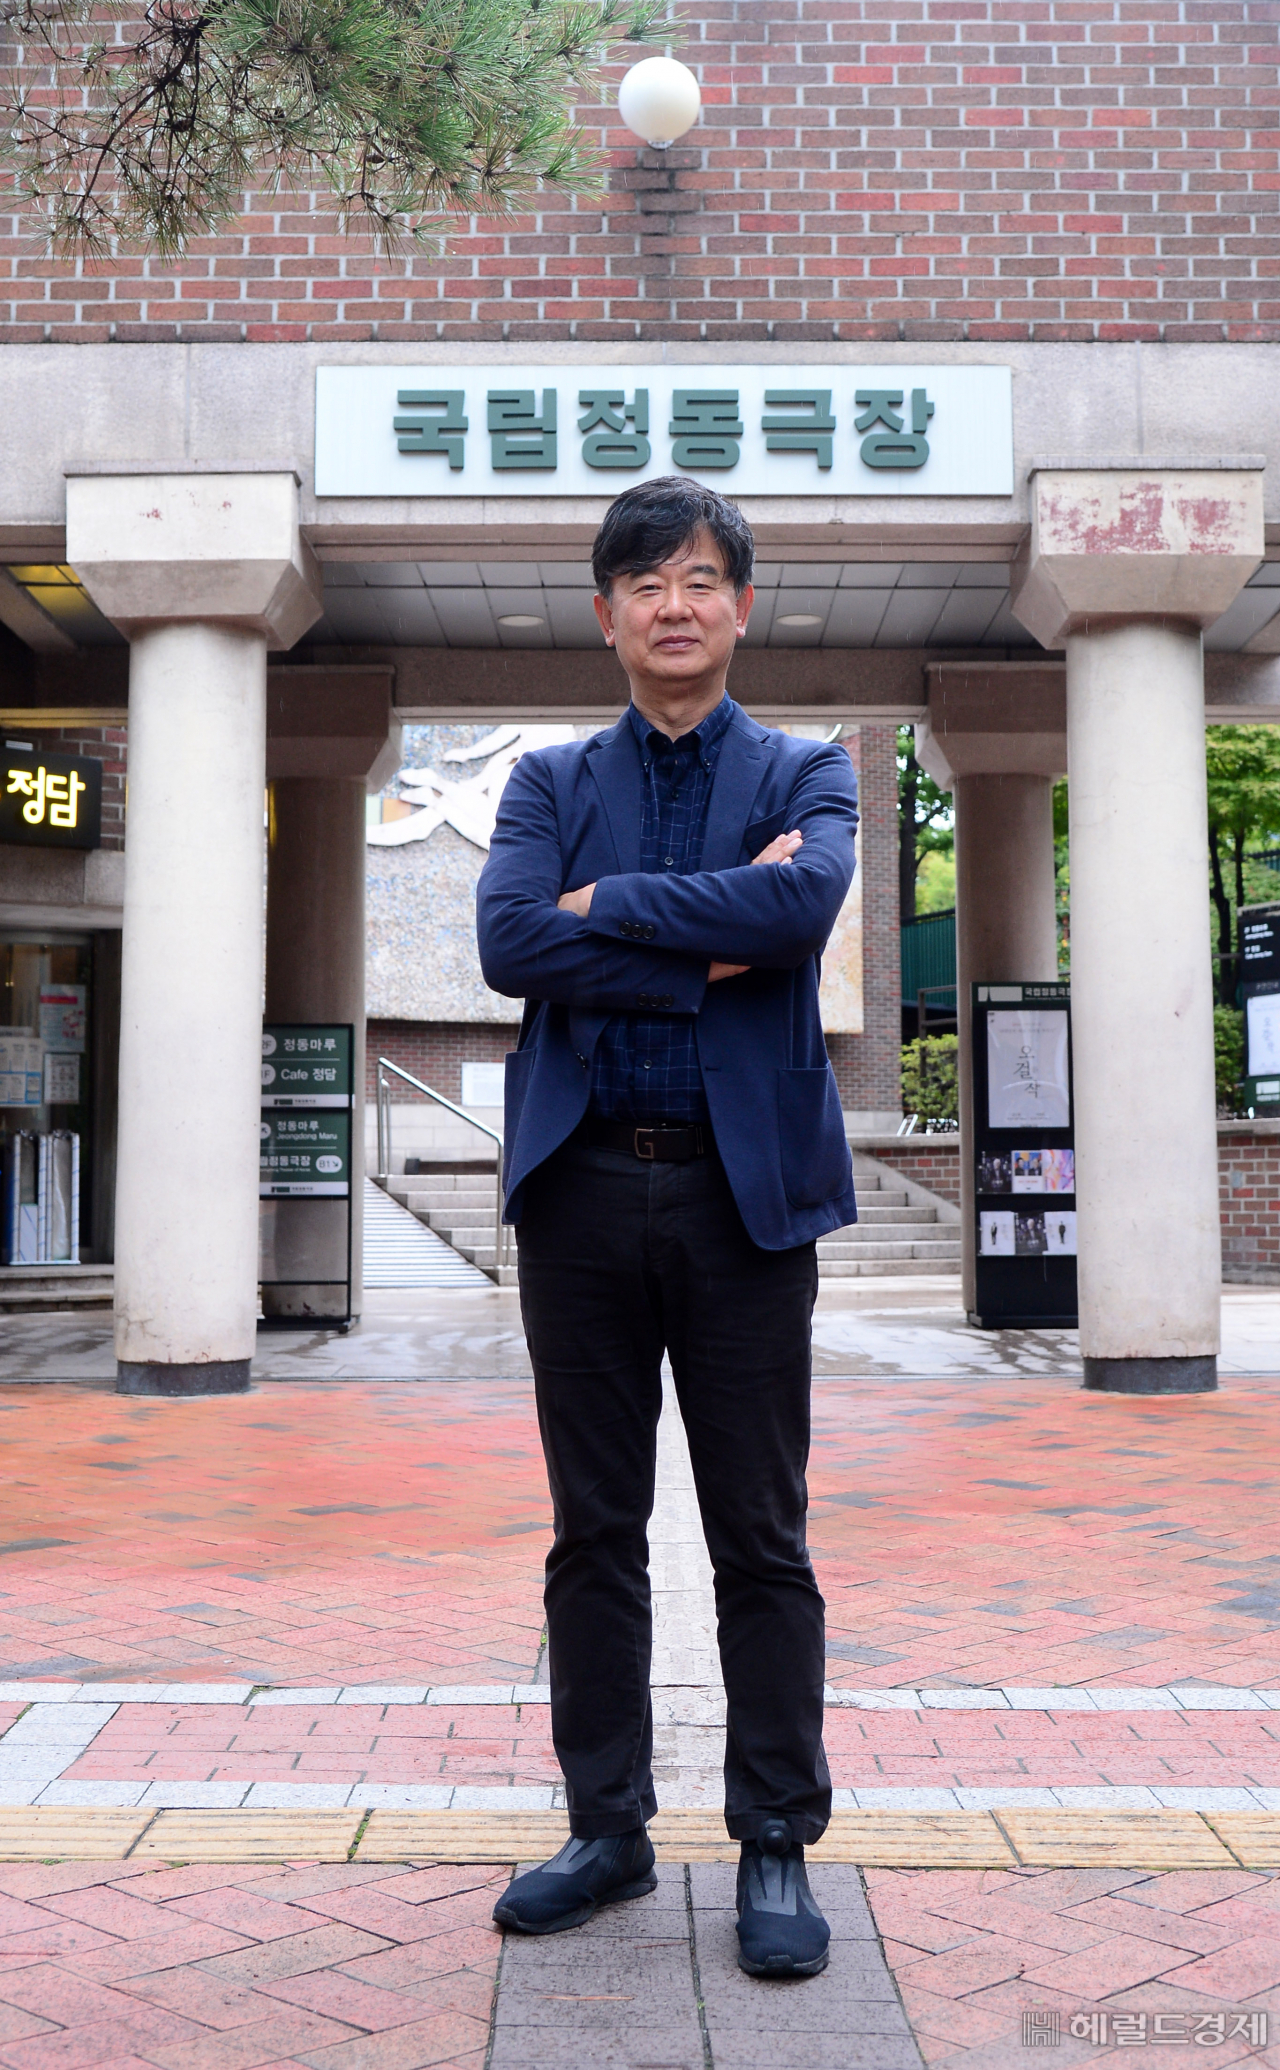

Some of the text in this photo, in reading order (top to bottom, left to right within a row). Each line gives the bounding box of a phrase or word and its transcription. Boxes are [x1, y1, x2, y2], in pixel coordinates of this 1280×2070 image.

[393, 388, 935, 471] 국립정동극장
[6, 766, 86, 828] 정담
[283, 1038, 337, 1052] 정동마루
[280, 1068, 309, 1080] Cafe
[312, 1067, 337, 1081] 정담
[277, 1121, 319, 1132] 정동마루
[277, 1132, 337, 1142] Jeongdong Maru
[319, 1159, 330, 1169] B1
